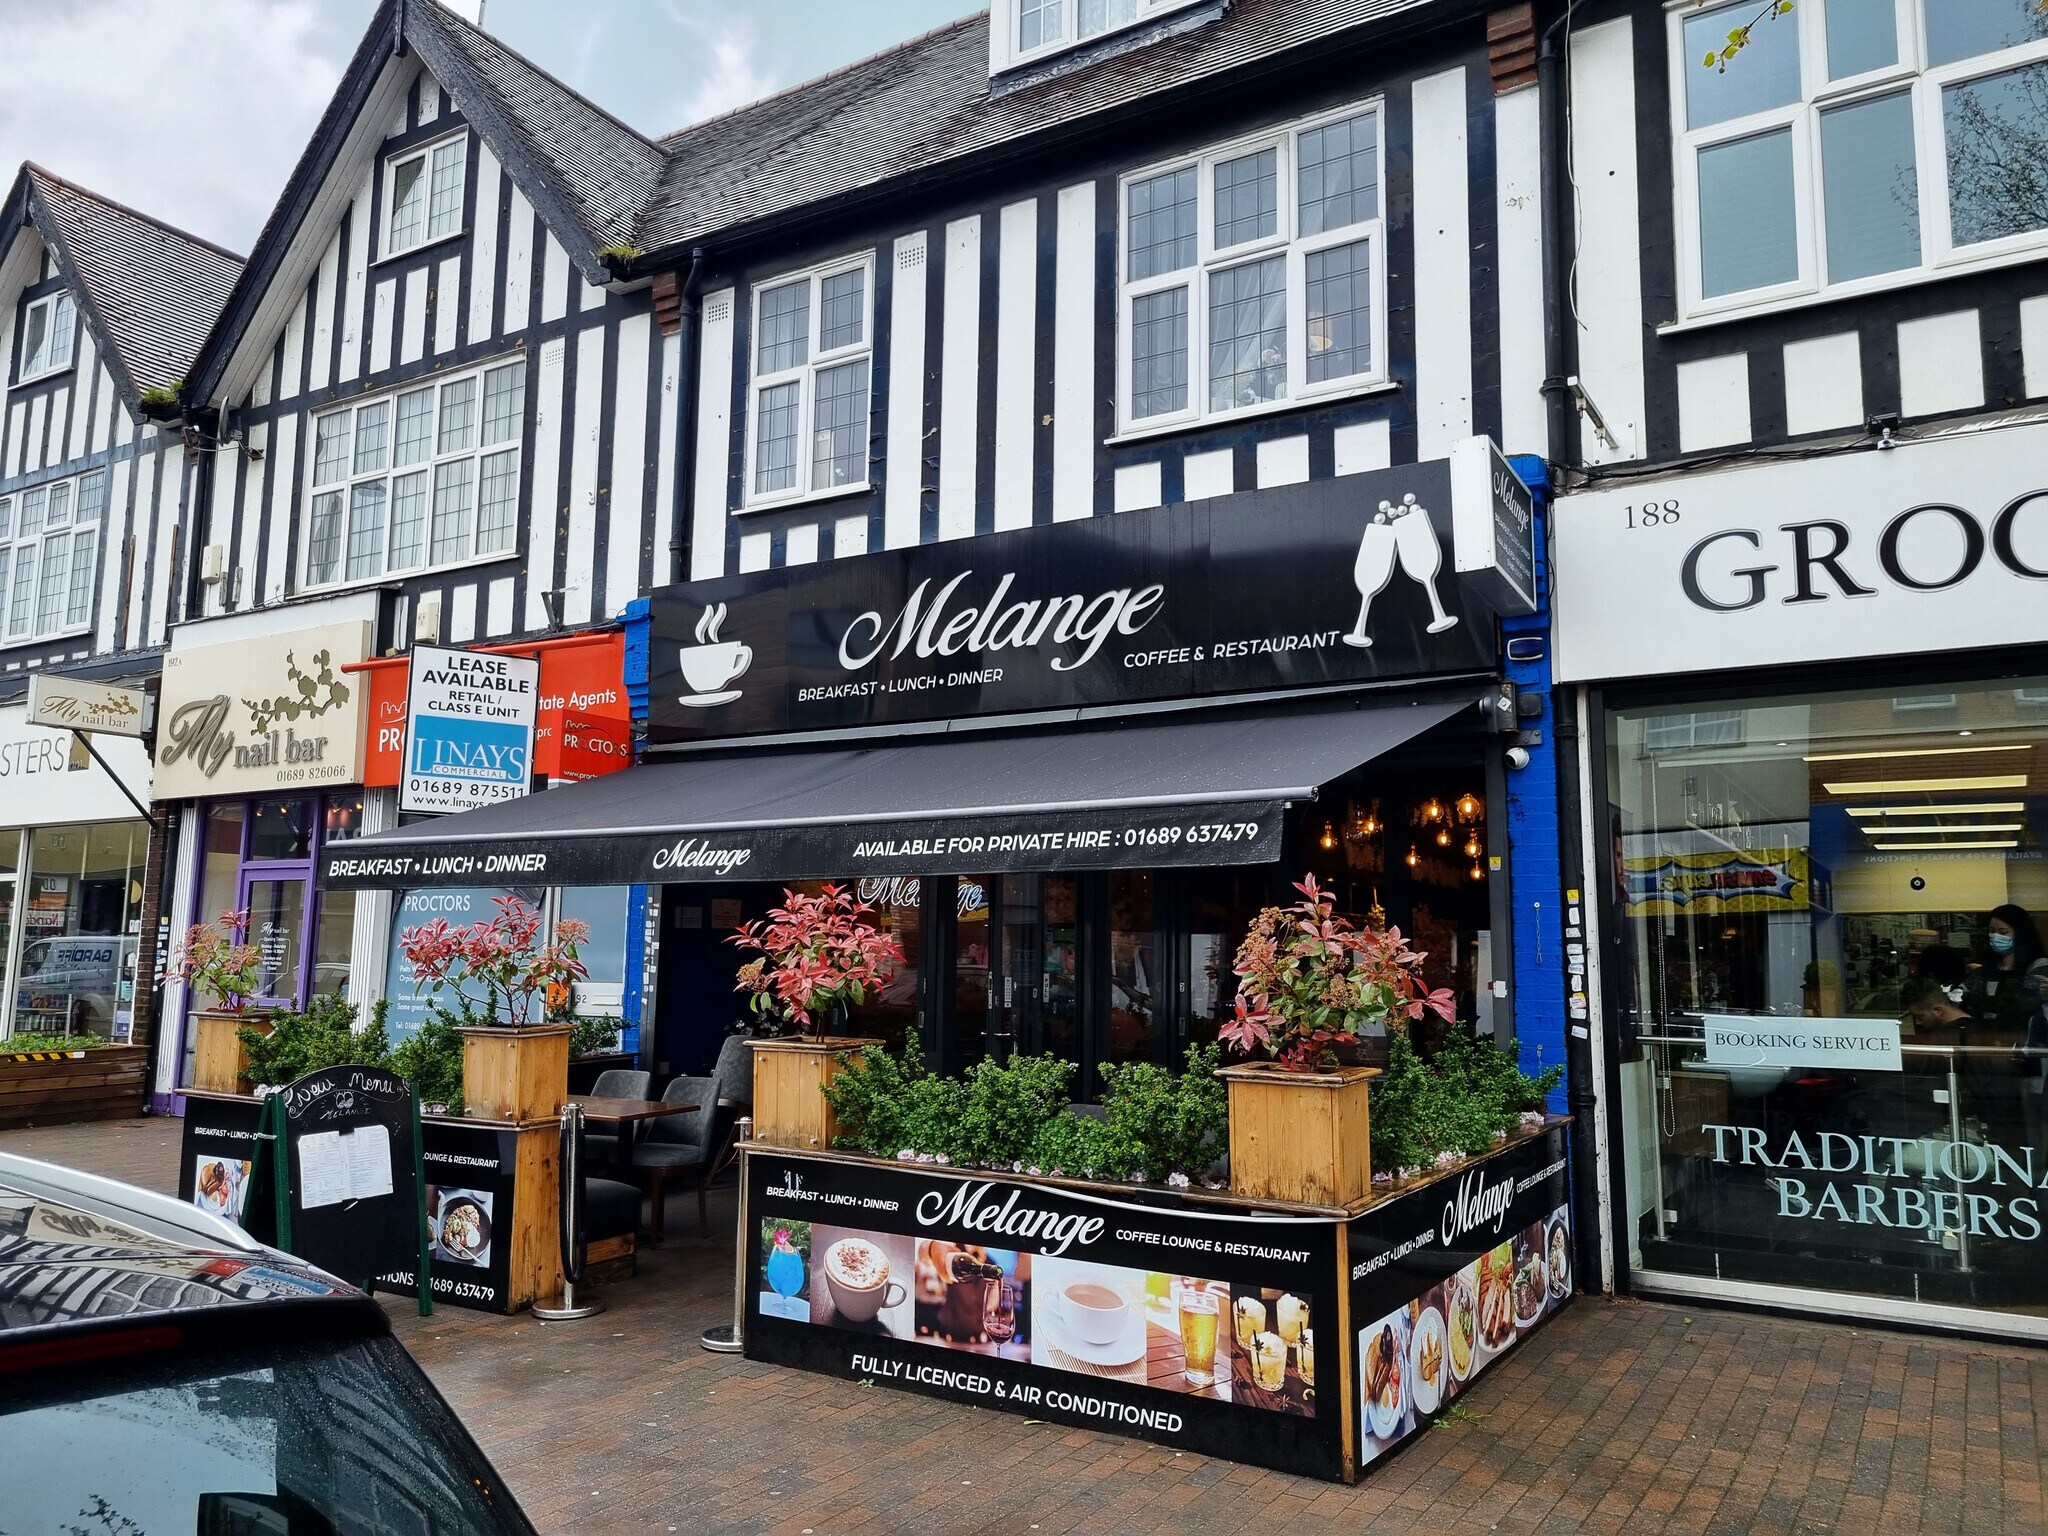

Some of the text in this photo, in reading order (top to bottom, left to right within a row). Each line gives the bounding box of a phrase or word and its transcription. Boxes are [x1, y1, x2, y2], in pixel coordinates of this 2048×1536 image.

[1493, 471, 1529, 533] Melange
[1624, 499, 1681, 529] 188
[838, 570, 1165, 672] Melange
[1123, 630, 1341, 669] COFFEE & RESTAURANT
[422, 669, 530, 694] AVAILABLE
[447, 656, 508, 676] LEASE
[449, 690, 495, 704] RETAIL
[568, 688, 617, 711] Agents
[798, 668, 1003, 702] BREAKFAST LUNCH DINNER
[39, 695, 81, 723] My
[82, 714, 129, 728] nail bar
[428, 700, 520, 719] CLASS E UNIT
[160, 694, 235, 779] My
[233, 728, 328, 768] nail bar
[0, 736, 66, 777] STERS
[414, 737, 524, 781] LINAYS
[434, 765, 504, 778] COMMERCIAL
[276, 764, 346, 782] 01689 826066
[410, 779, 524, 799] 01689 875511
[652, 838, 751, 875] Melange
[853, 838, 946, 858] AVAILABLE
[947, 836, 985, 854] FOR
[987, 832, 1063, 852] PRIVATE
[1066, 830, 1111, 849] HIRE
[1124, 827, 1182, 847] 01689
[1185, 823, 1259, 844] 637479
[328, 854, 546, 877] BREAKFAST LUNCH DINNER
[404, 894, 471, 912] PROCTORS
[1714, 1032, 1891, 1051] BOOKING SERVICE
[298, 1072, 396, 1107] New Menu
[194, 1126, 227, 1137] BREAKFAST
[230, 1130, 249, 1140] LUNCH
[423, 1152, 448, 1163] OUNGE
[453, 1155, 500, 1169] RESTAURANT
[1701, 1123, 2048, 1189] TRADITION
[766, 1186, 899, 1212] BREAKFAST LUNCH DINNER
[1441, 1169, 1515, 1247] Melange
[1775, 1177, 2041, 1241] BARBERS
[915, 1180, 1105, 1256] Melange
[1115, 1229, 1311, 1263] COFFEE LOUNGE & RESTAURANT
[1352, 1228, 1435, 1281] BREAKFAST LUNCH DINNER
[455, 1282, 495, 1301] 637479
[851, 1354, 1183, 1433] FULLY LICENCED & AIR CONDITIONED
